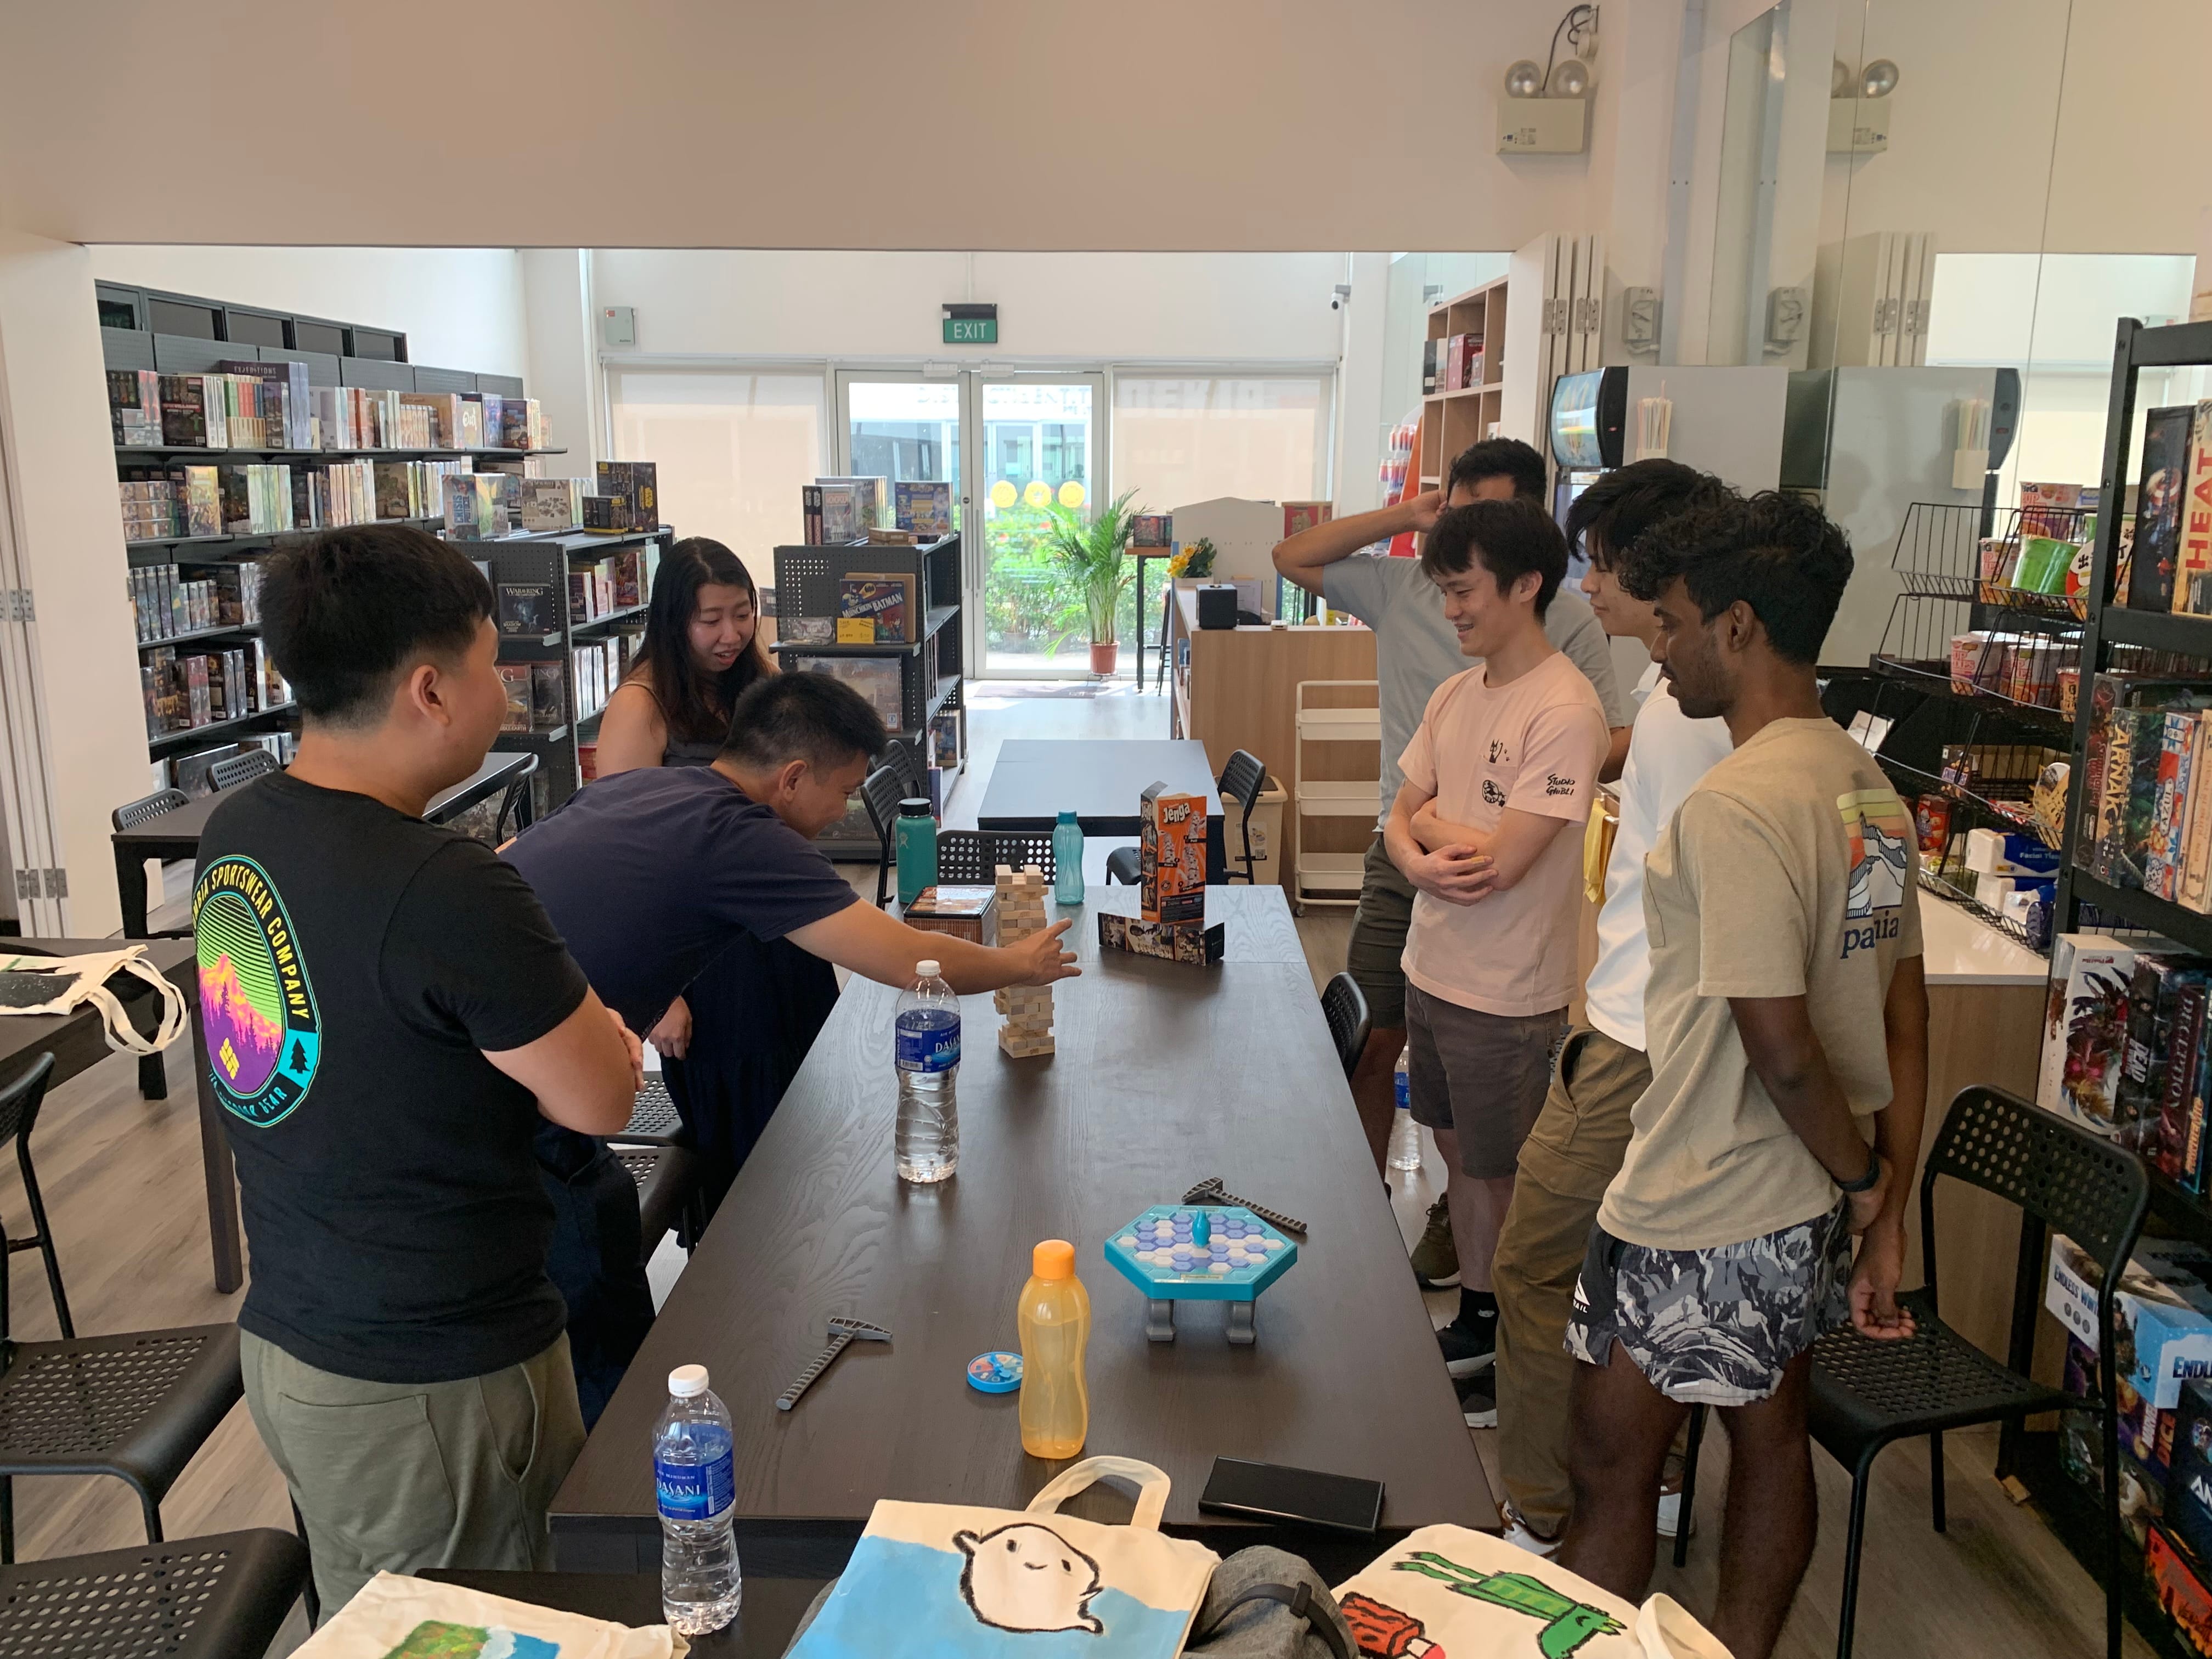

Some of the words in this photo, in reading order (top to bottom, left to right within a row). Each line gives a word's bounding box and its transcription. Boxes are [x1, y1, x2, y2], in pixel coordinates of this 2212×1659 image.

[953, 322, 987, 339] EXIT
[453, 495, 462, 523] CRISIS
[2186, 448, 2212, 569] HEAT
[842, 601, 873, 619] MUNCHKIN
[872, 592, 904, 612] BATMAN
[1547, 774, 1575, 786] STUDIO
[2104, 723, 2130, 822] ARNAK
[1546, 786, 1575, 796] GHIBLI
[1163, 802, 1190, 823] Jenga
[2162, 786, 2173, 831] AZUL
[212, 864, 273, 919] SPORTSWEAR
[267, 917, 309, 1024] COMPANY
[2132, 1042, 2149, 1084] DEAD
[258, 1086, 287, 1114] GEAR
[2185, 1097, 2204, 1175] PANDEMIC
[2054, 1263, 2079, 1299] ENDLESS
[2157, 1410, 2176, 1469] DICE
[656, 1477, 700, 1497] DASANI
